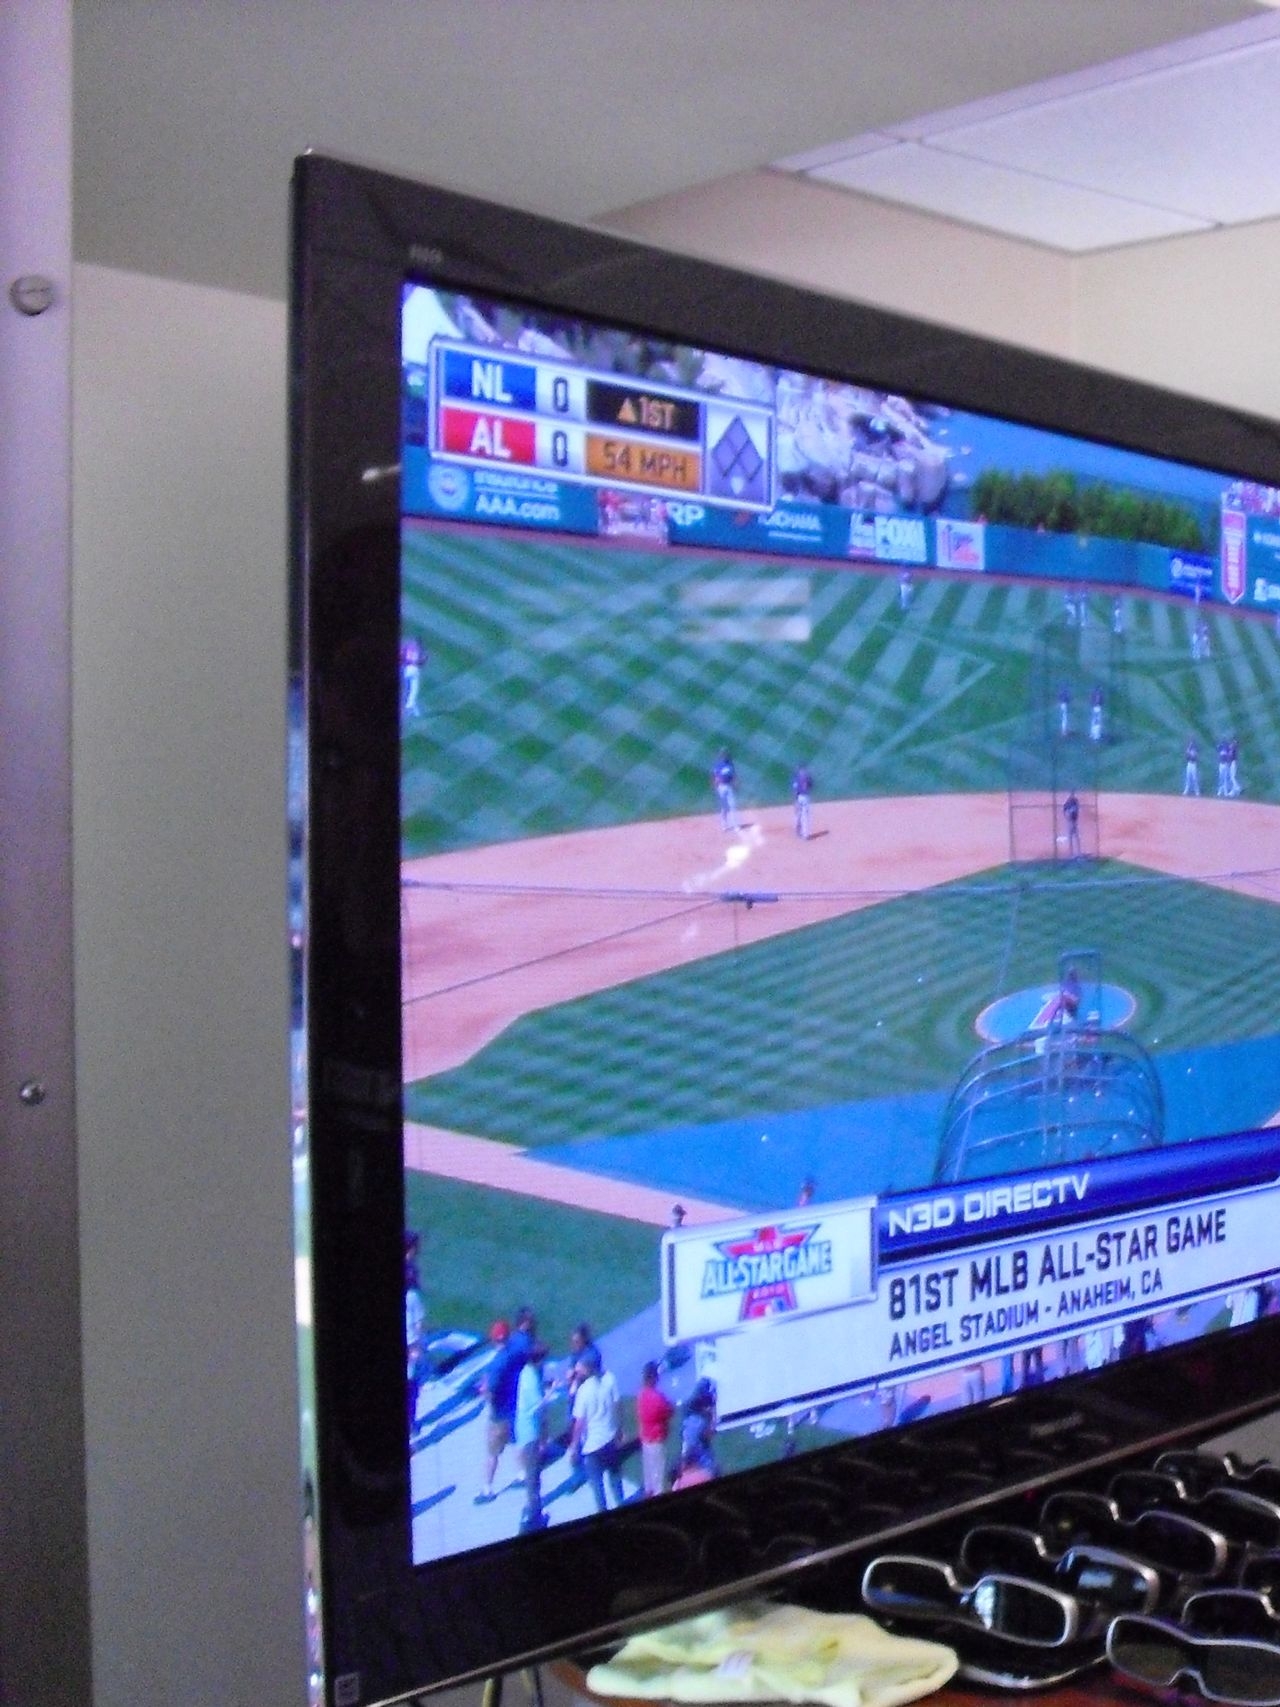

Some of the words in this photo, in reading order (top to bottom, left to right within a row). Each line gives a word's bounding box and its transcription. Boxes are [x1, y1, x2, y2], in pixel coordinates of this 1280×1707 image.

[470, 359, 513, 403] NL
[551, 376, 569, 414] 0
[639, 396, 675, 430] 1ST
[469, 416, 512, 459] AL
[551, 429, 569, 467] 0
[602, 442, 630, 470] 54
[638, 452, 687, 482] MPH
[475, 494, 560, 521] AAA.com
[888, 1197, 955, 1238] N3D
[963, 1172, 1090, 1223] DIRECTV
[888, 1268, 959, 1321] 81ST
[969, 1250, 1028, 1301] MLB
[1038, 1223, 1158, 1285] ALL-STAR
[1166, 1208, 1226, 1254] GAME
[888, 1323, 952, 1362] ANGEL
[960, 1300, 1038, 1343] STADIUM
[1058, 1278, 1135, 1317] ANAHEIM,
[1141, 1268, 1163, 1296] CA
